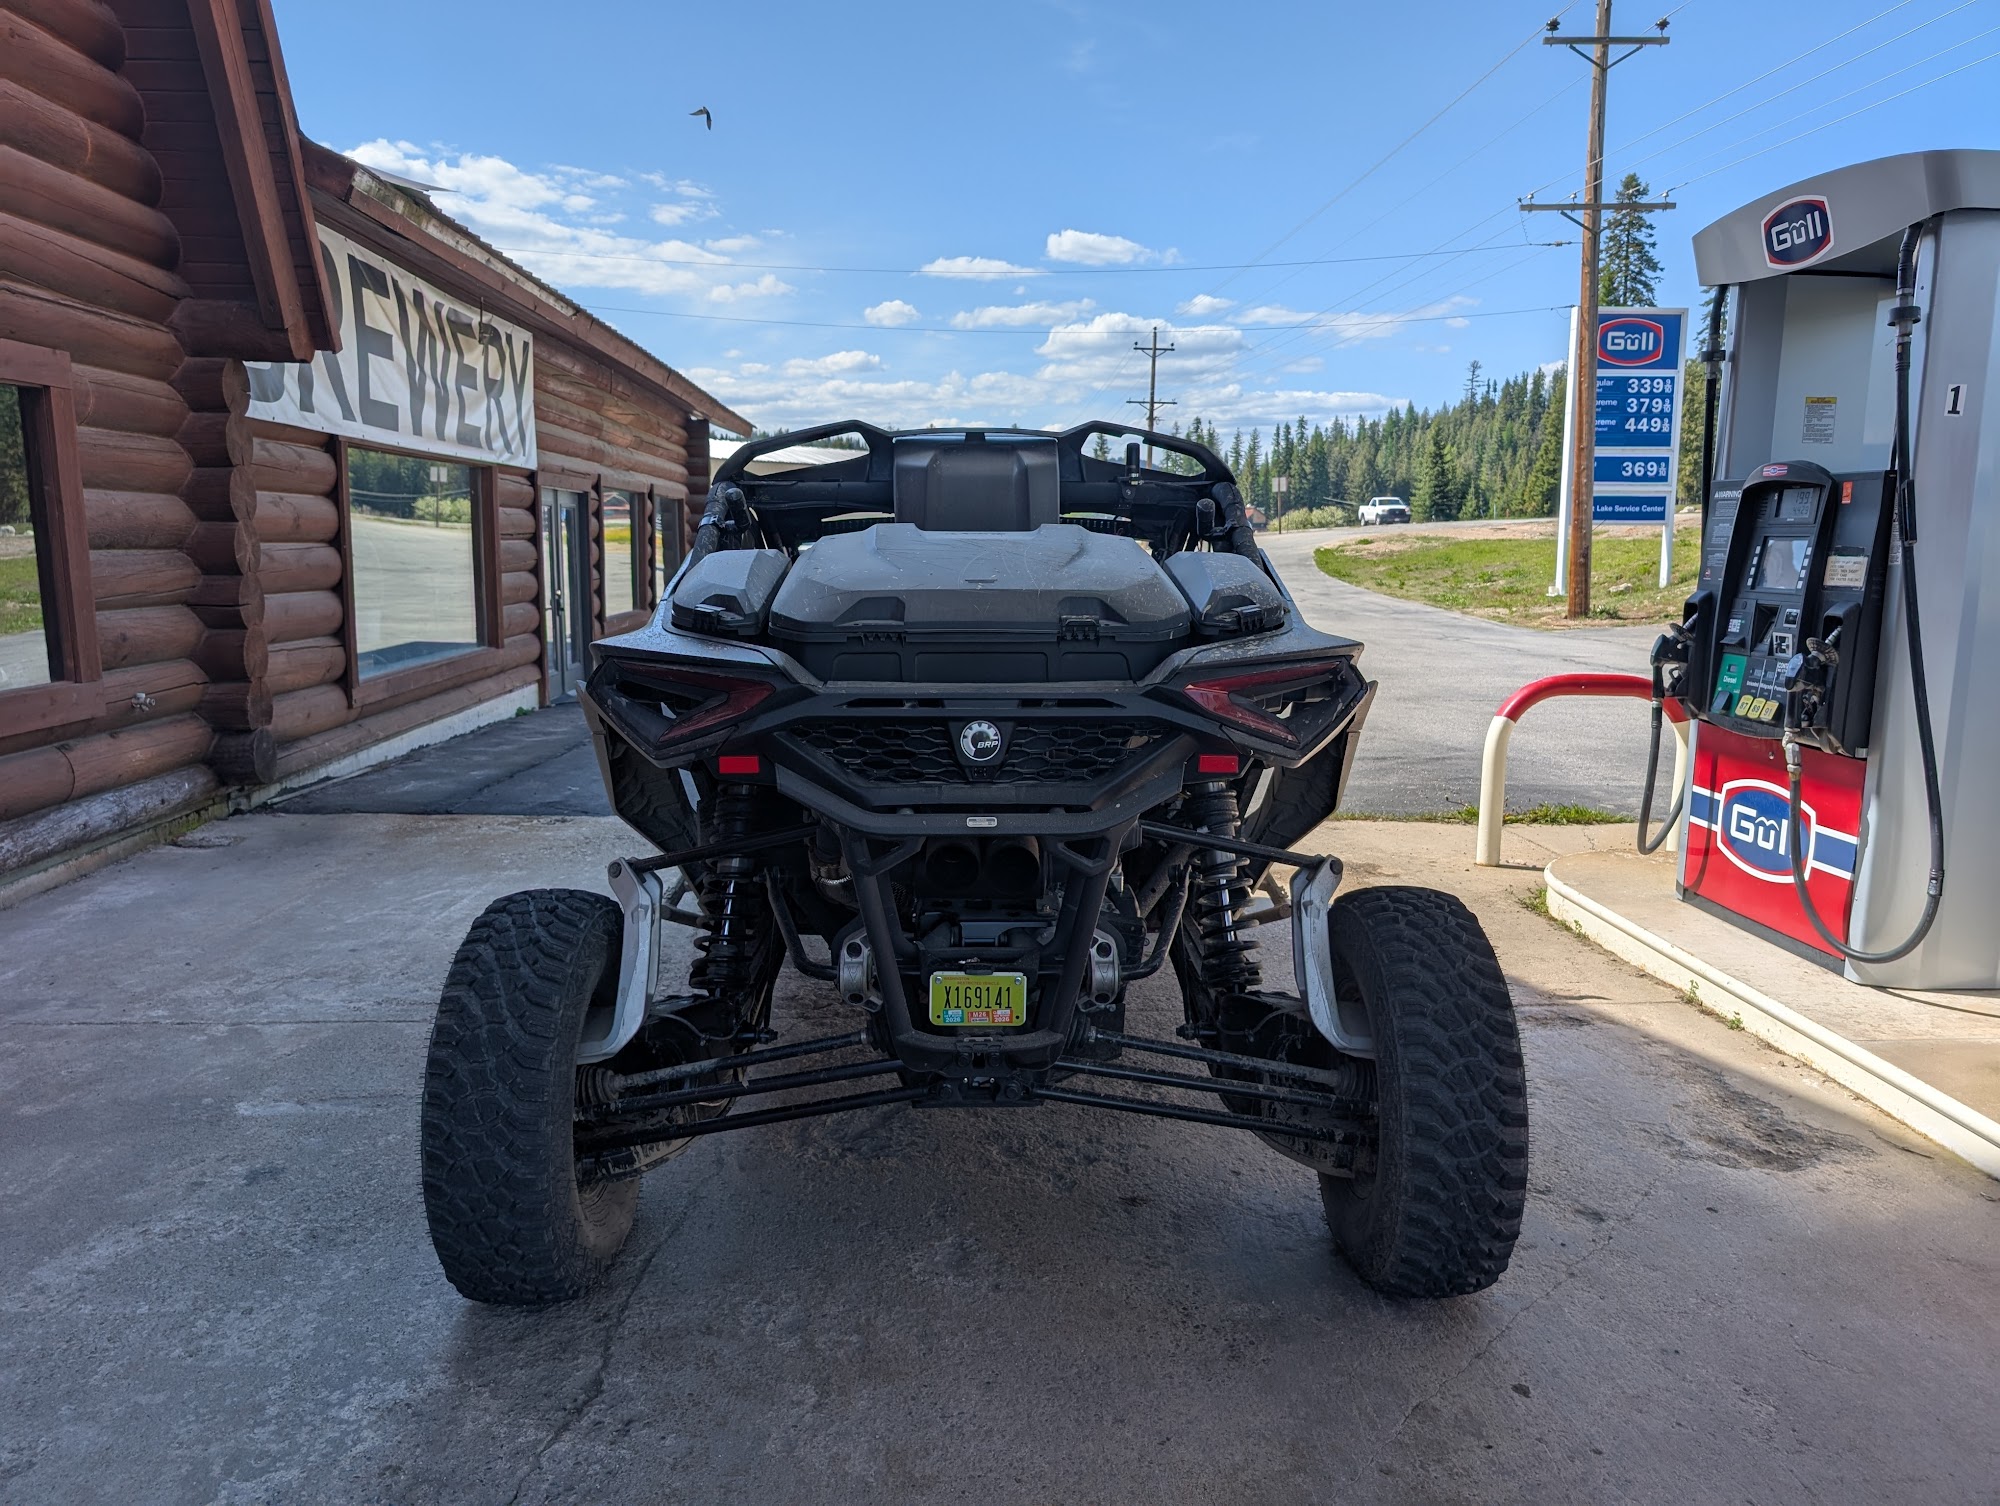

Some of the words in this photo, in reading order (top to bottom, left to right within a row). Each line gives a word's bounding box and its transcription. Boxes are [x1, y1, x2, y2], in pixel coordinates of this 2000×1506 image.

[1770, 209, 1823, 252] Gull
[1606, 331, 1654, 351] Gull
[1627, 378, 1664, 394] 339
[1626, 398, 1663, 413] 379
[1947, 385, 1961, 415] 1
[1624, 417, 1661, 433] 449
[1621, 461, 1658, 477] 369
[1596, 504, 1613, 512] Lake
[1614, 504, 1640, 512] Service
[1641, 504, 1665, 512] Center
[1723, 675, 1738, 684] Diesel
[1739, 701, 1750, 710] 87
[1751, 704, 1762, 713] 89
[977, 741, 998, 749] BRP
[1730, 803, 1790, 857] Gul
[944, 985, 1013, 1009] X169141
